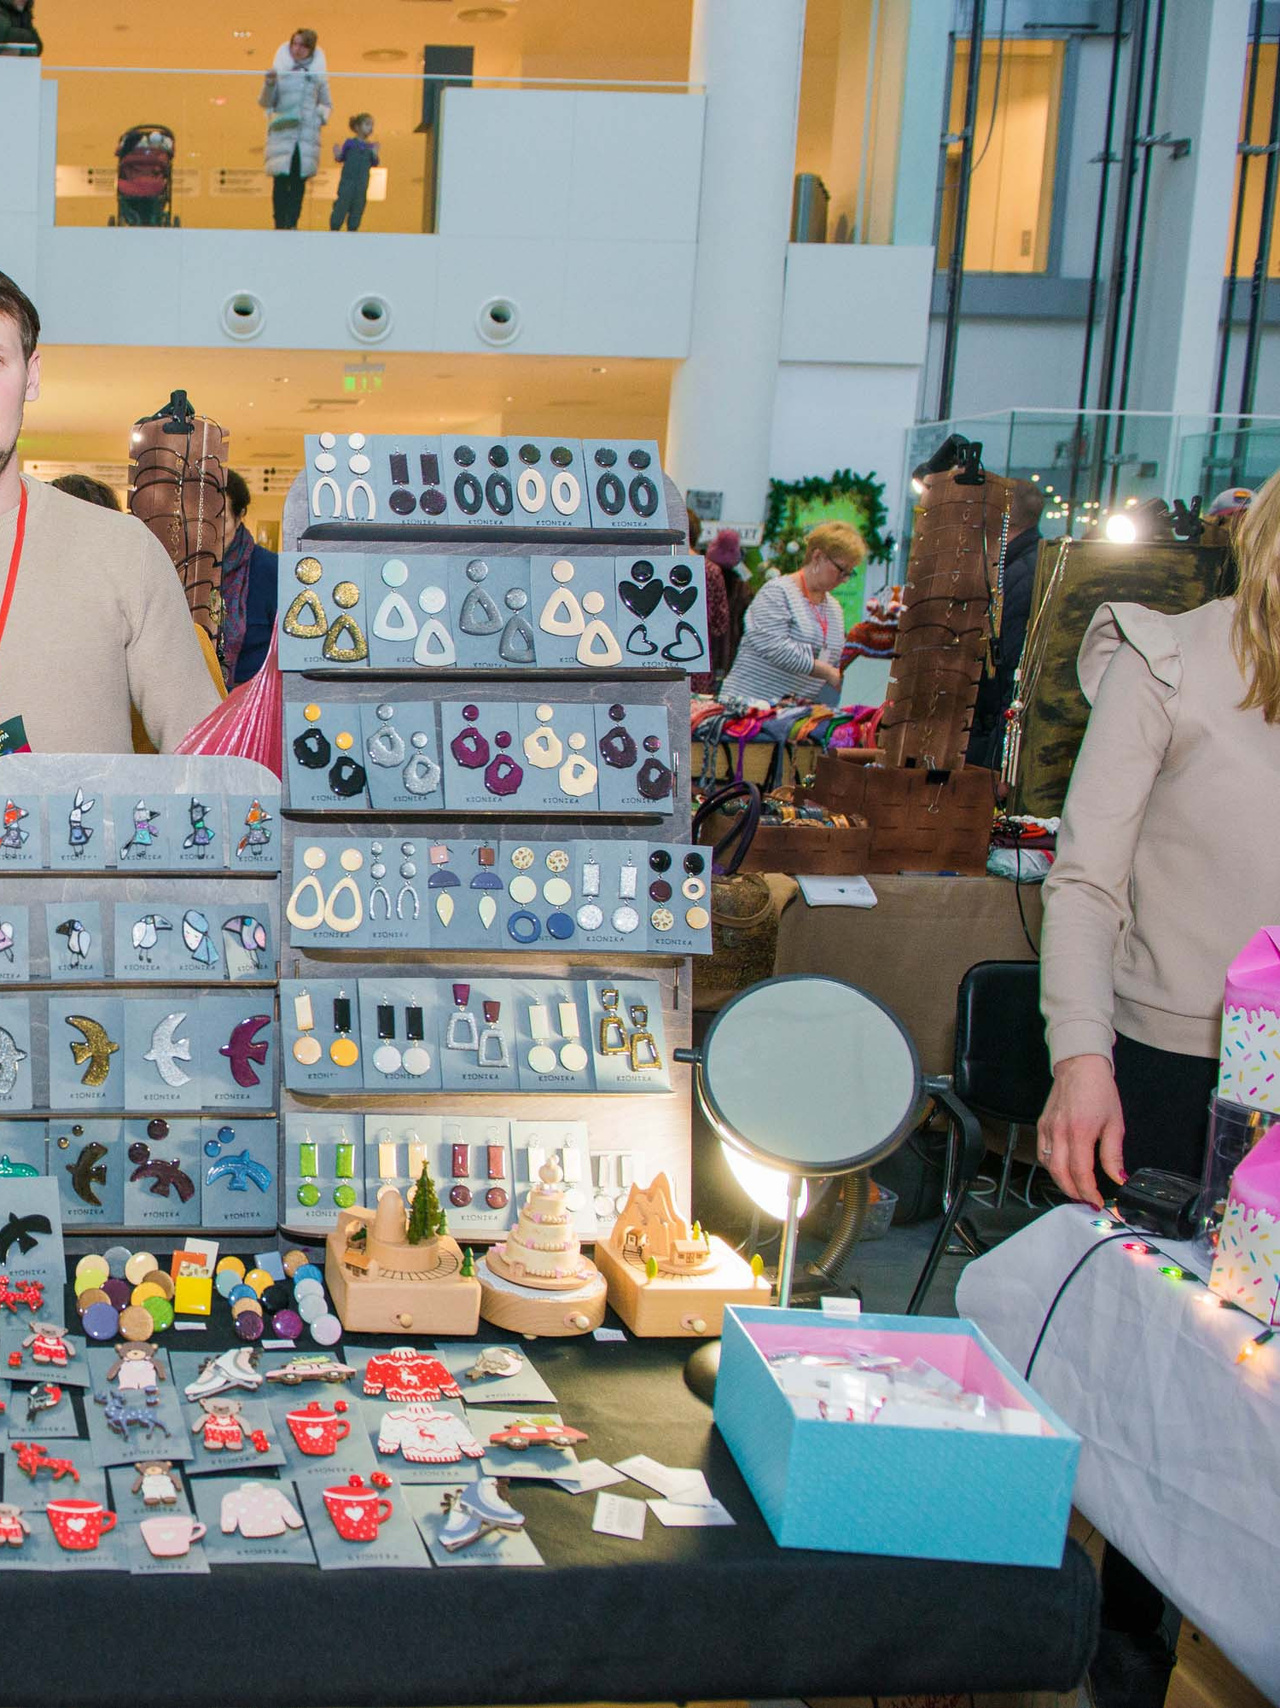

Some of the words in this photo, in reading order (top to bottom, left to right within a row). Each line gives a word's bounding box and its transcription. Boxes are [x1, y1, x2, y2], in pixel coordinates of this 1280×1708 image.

[401, 518, 438, 526] KIONIKA
[468, 518, 504, 526] KIONIKA
[611, 520, 648, 528] KIONIKA
[542, 796, 581, 804] KIONIKA
[654, 937, 693, 946] KIONIKA
[179, 964, 216, 972] KIONIKA
[462, 1073, 500, 1081] KIONIKA
[69, 1092, 107, 1100] KIONIKA
[143, 1093, 181, 1102] KIONIKA
[214, 1092, 252, 1101] KIONIKA
[67, 1208, 106, 1217] KIONIKA
[143, 1211, 181, 1219] KIONIKA
[223, 1210, 262, 1220] KIONIKA
[461, 1213, 499, 1222] KIONIKA
[8, 1268, 47, 1277] KIONIKA
